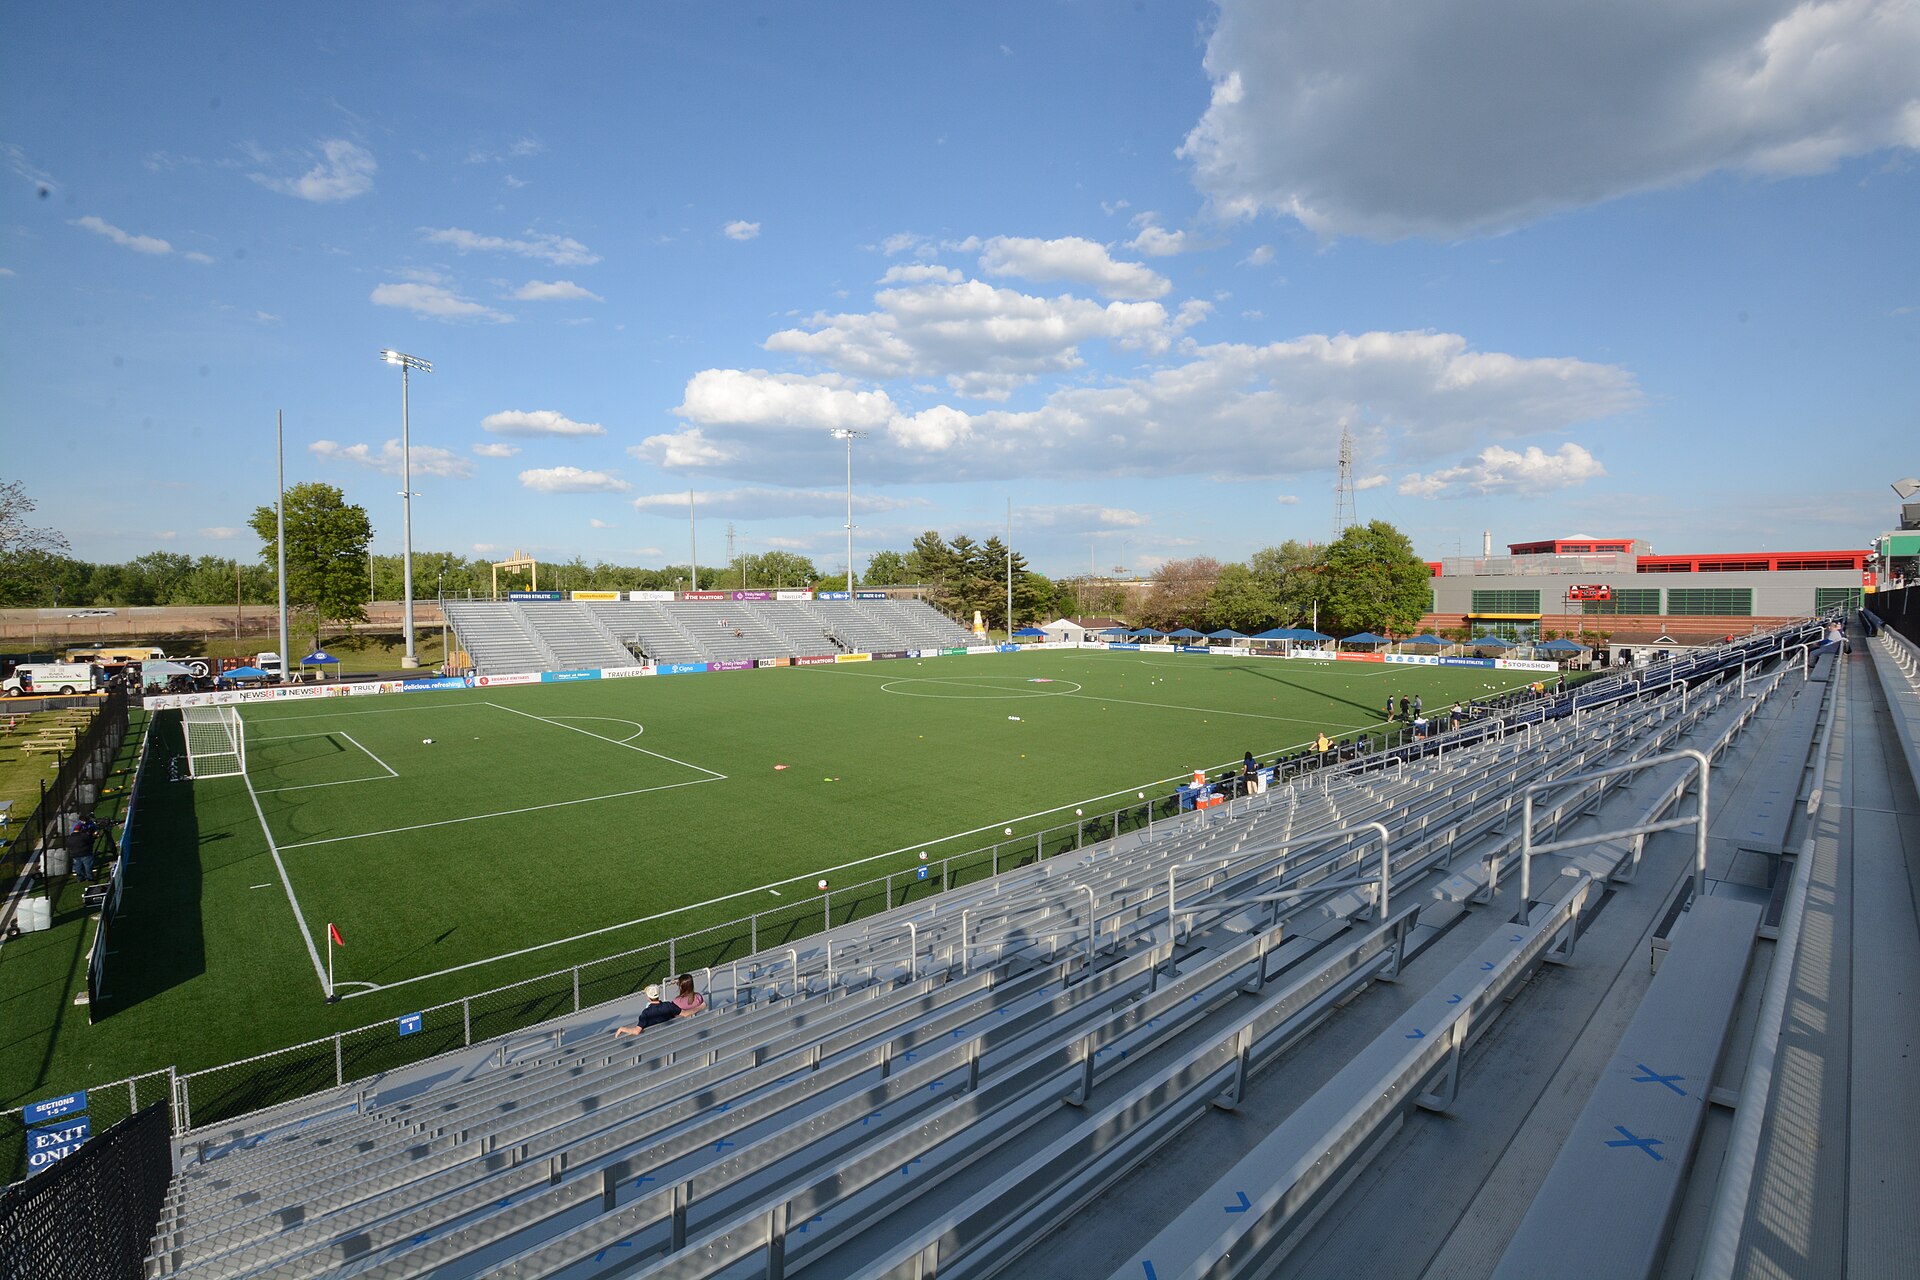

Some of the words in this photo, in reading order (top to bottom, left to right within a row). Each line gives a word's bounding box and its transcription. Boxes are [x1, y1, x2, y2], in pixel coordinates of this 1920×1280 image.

[608, 670, 643, 678] TRAVELERS
[401, 1015, 420, 1024] SECTION
[408, 1022, 413, 1030] 1
[36, 1096, 75, 1112] SECTIONS
[36, 1124, 87, 1149] EXIT
